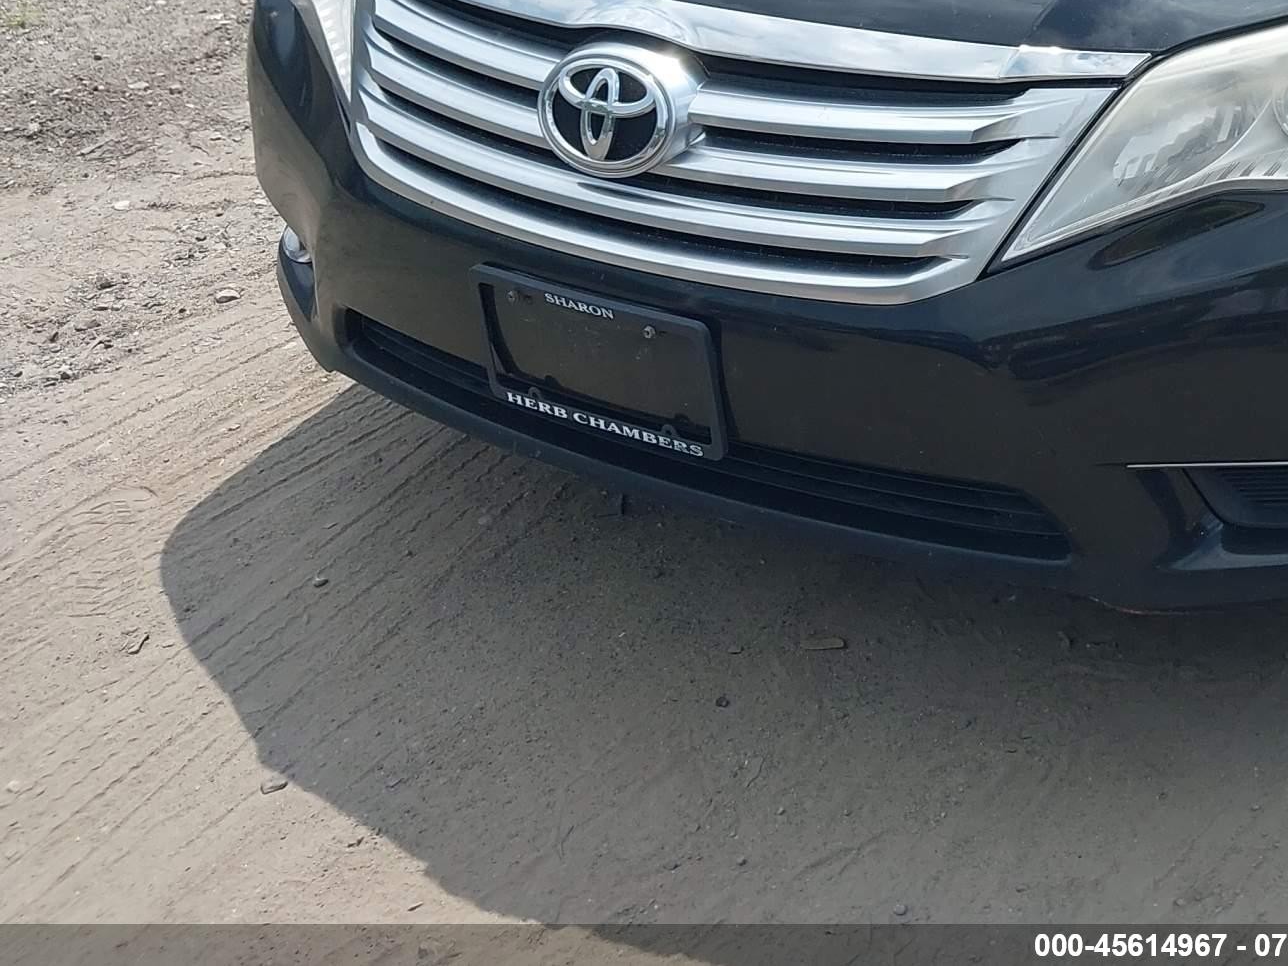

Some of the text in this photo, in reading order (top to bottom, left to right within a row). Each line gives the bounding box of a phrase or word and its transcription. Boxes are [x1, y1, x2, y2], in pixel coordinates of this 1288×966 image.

[544, 292, 614, 320] SHARON
[506, 391, 705, 458] HERB CHAMBERS
